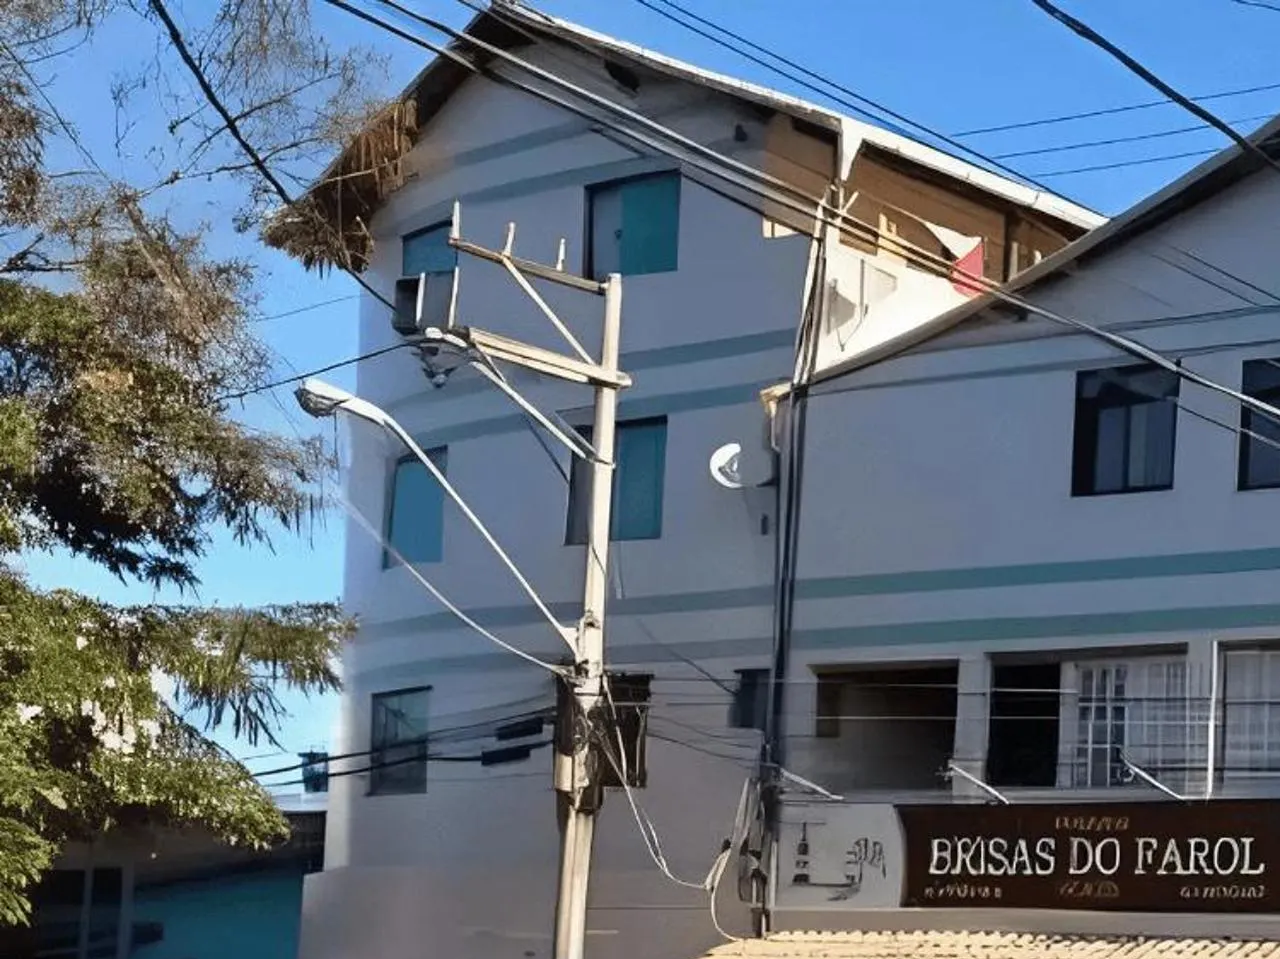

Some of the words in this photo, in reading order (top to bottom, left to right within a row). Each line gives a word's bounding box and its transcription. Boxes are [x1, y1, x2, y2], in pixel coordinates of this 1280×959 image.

[928, 837, 1056, 875] BRISAS
[1068, 837, 1121, 875] DO
[1134, 837, 1265, 875] FAROL
